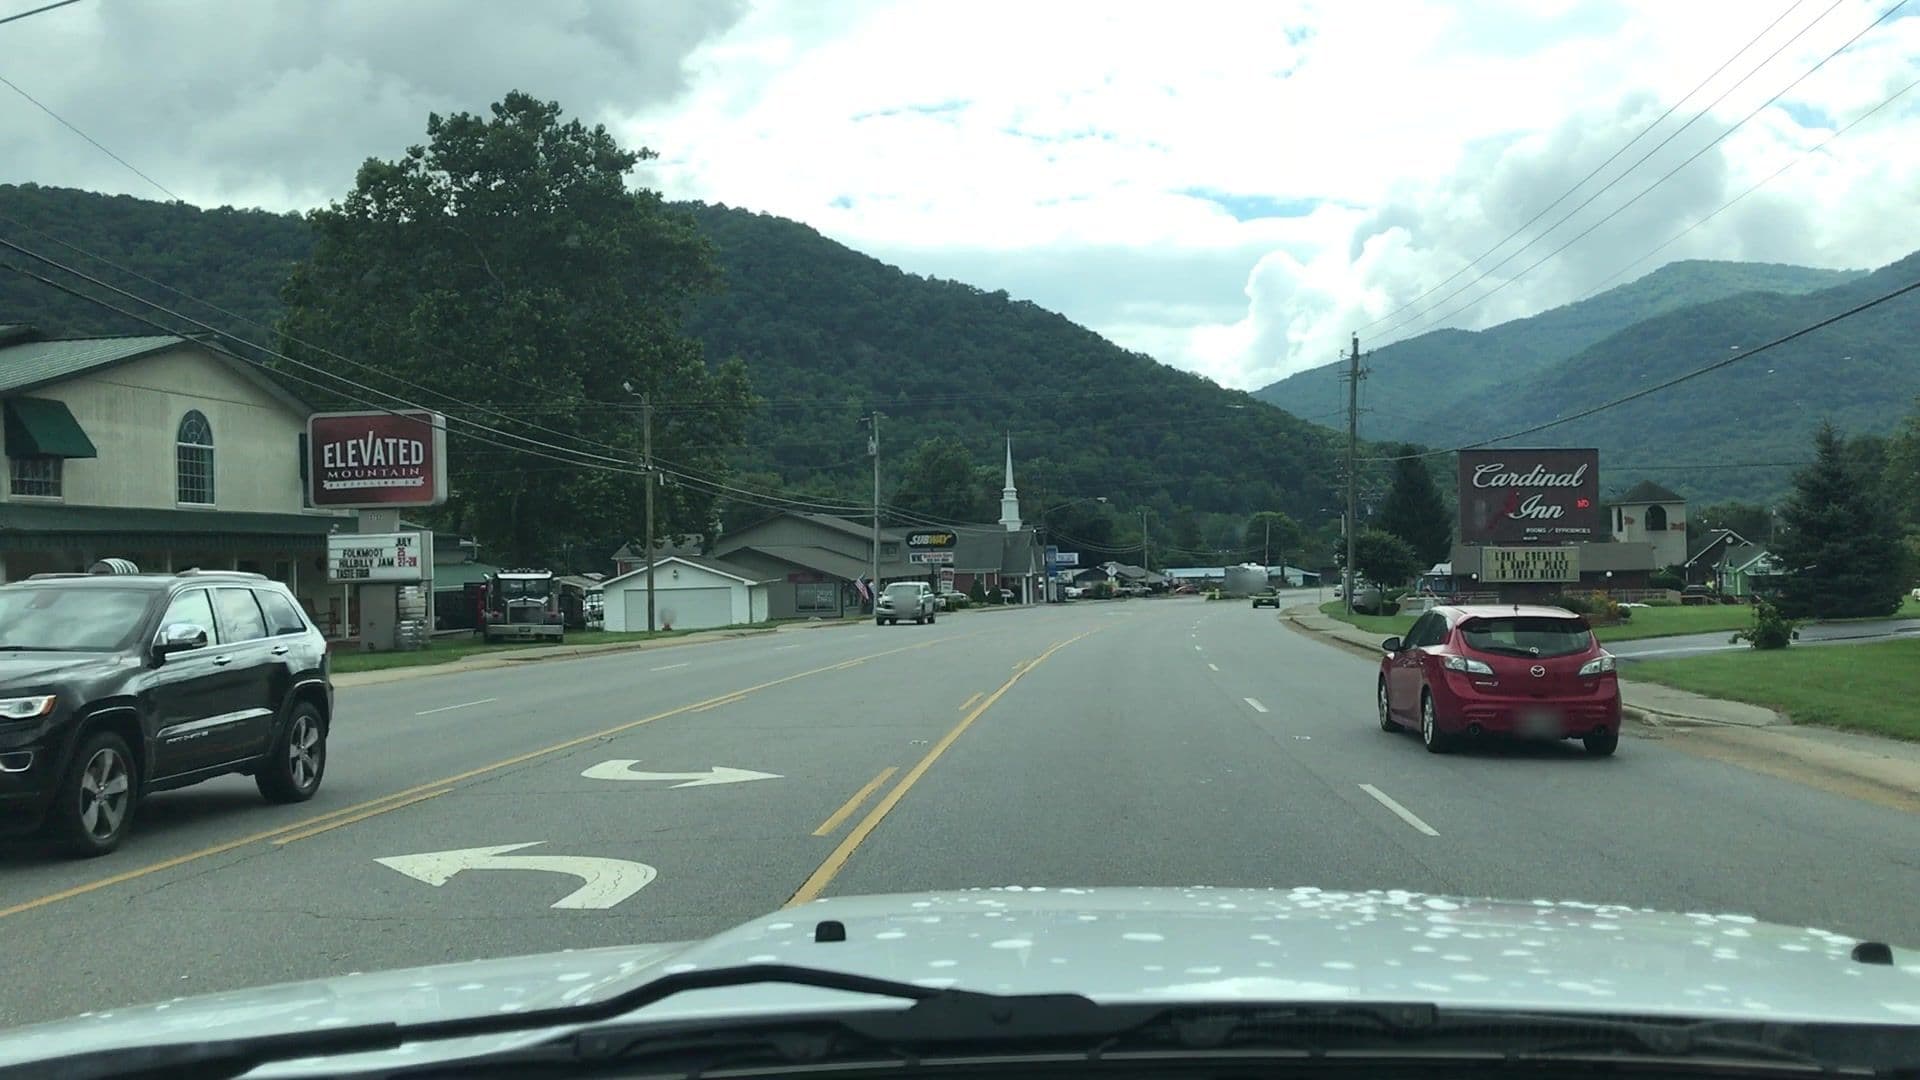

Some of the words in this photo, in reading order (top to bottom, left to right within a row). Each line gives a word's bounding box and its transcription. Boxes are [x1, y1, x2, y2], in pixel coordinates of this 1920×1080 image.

[323, 431, 424, 468] ELEVATED
[328, 468, 420, 478] MOUNTAIN
[1473, 463, 1588, 488] Cardinal
[1506, 494, 1564, 519] Inn
[395, 537, 411, 547] JULY
[909, 534, 953, 545] SUBWAY
[343, 548, 384, 558] FOLKMOOT
[1495, 551, 1516, 560] LOVE
[339, 558, 373, 568] HILLBILLY
[377, 557, 394, 567] JAM
[1511, 560, 1537, 569] HAPPY
[1545, 560, 1569, 569] PLACE
[336, 569, 355, 579] TASTE
